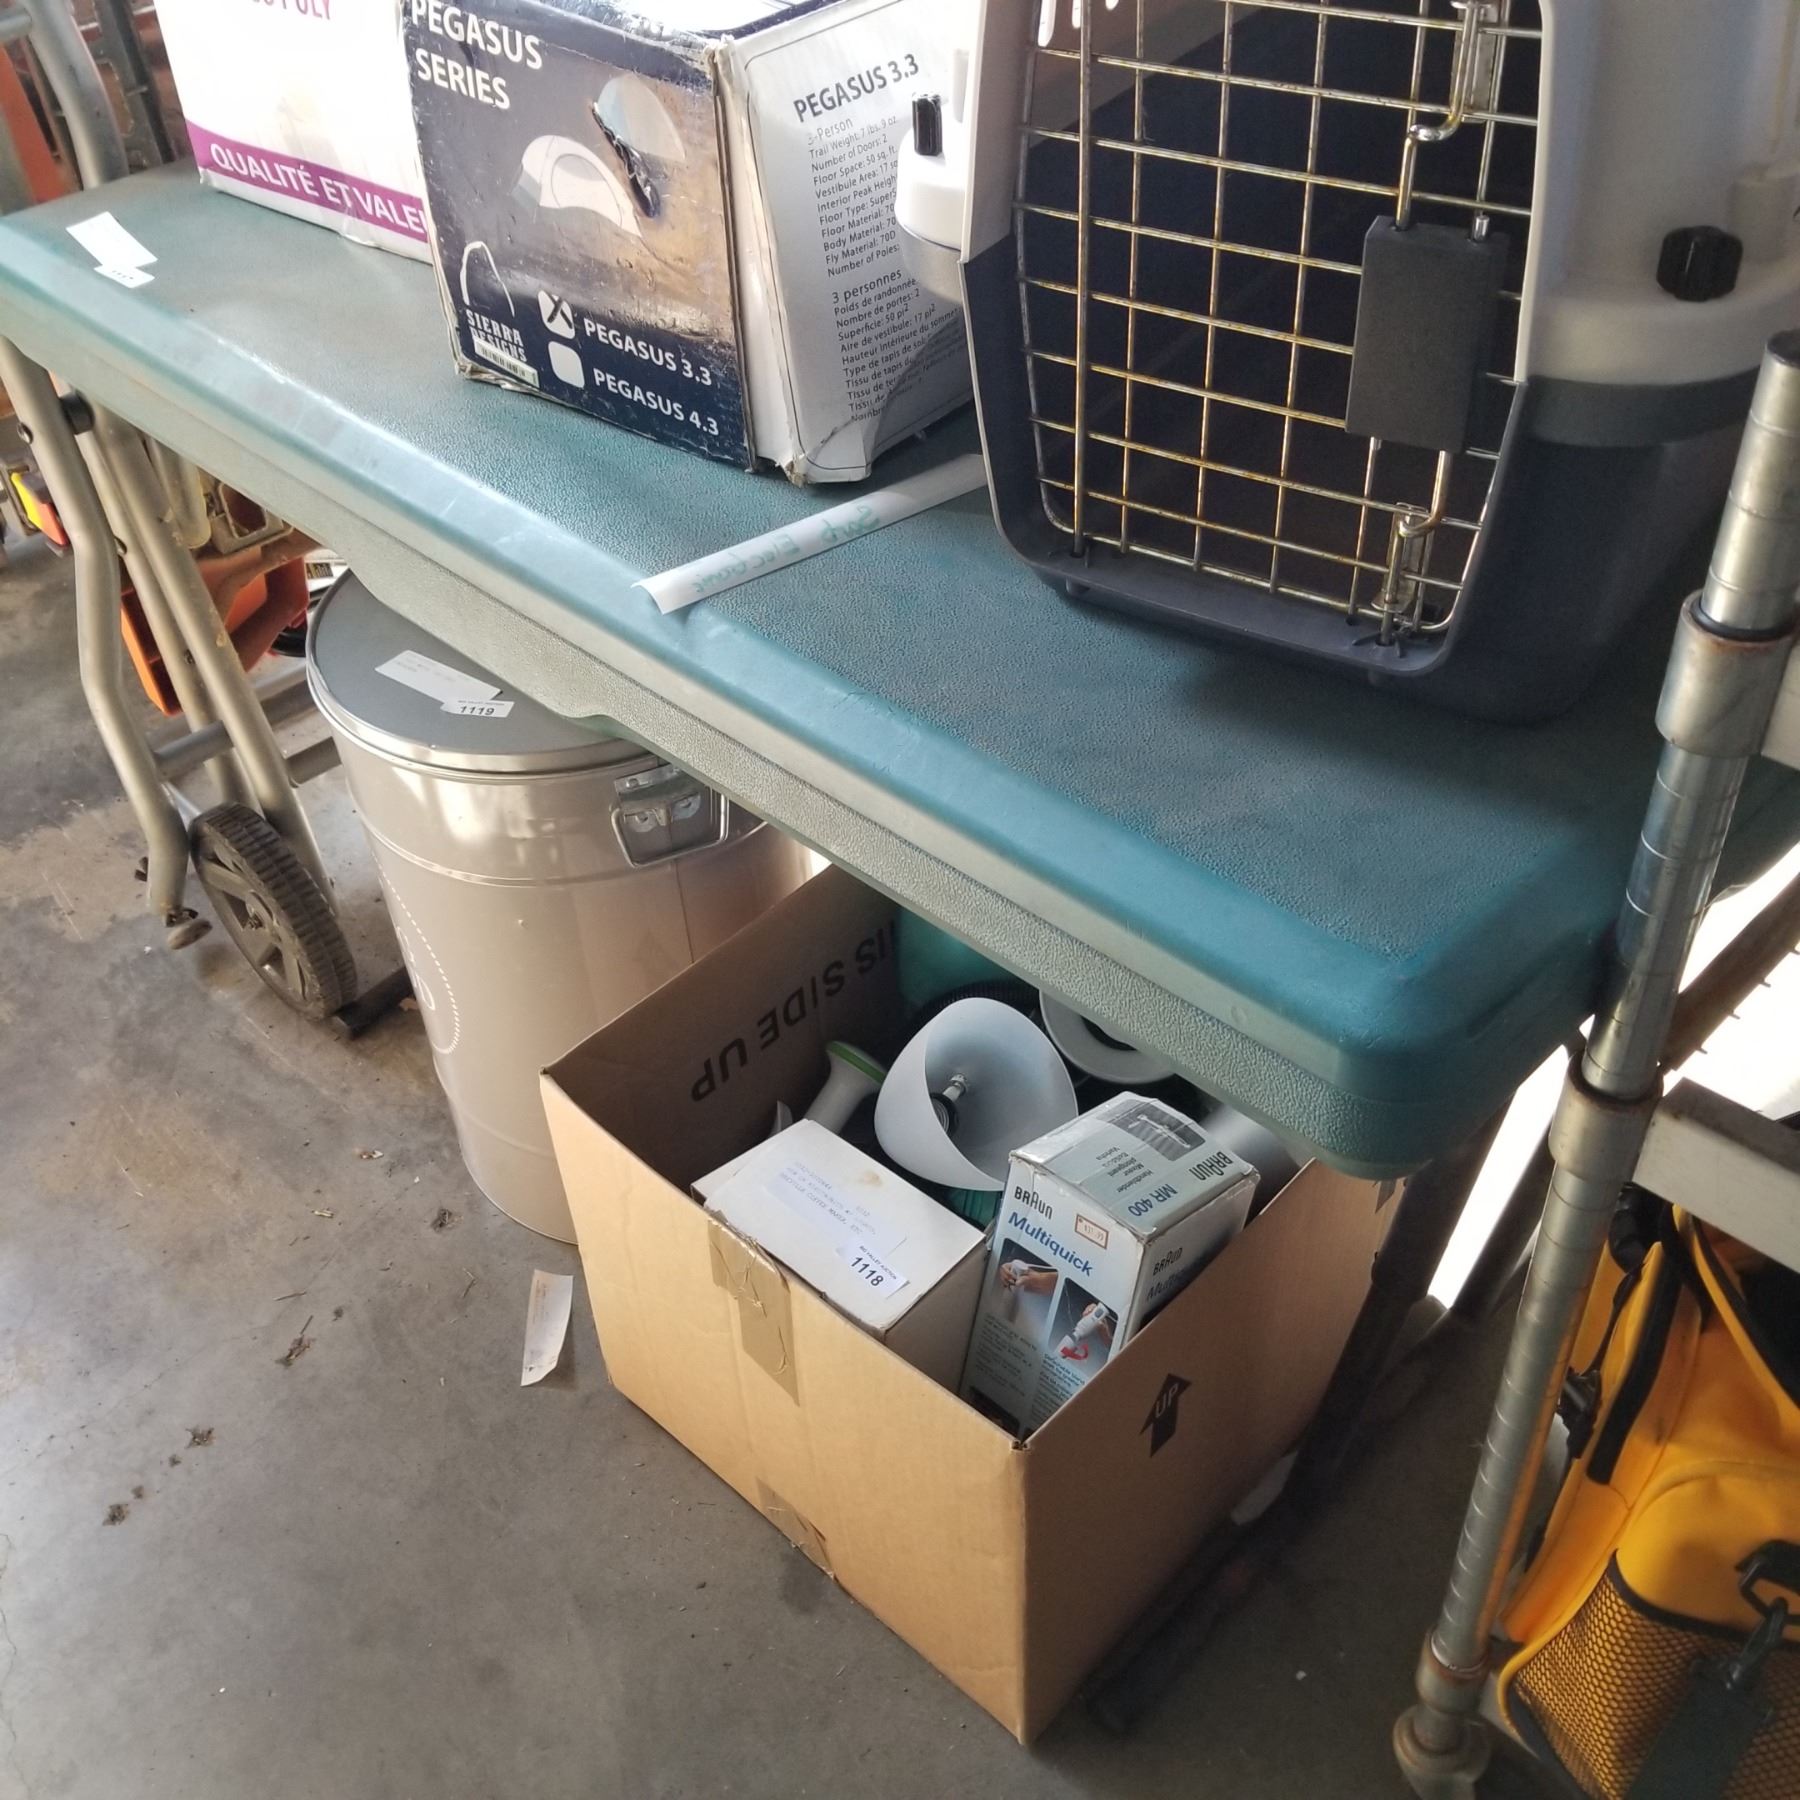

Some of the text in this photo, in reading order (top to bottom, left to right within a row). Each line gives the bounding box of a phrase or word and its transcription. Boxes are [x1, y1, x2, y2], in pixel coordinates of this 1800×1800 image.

[410, 0, 543, 70] PEGASUS
[415, 47, 511, 110] SERIES
[793, 53, 919, 123] PEGASUS 3.3
[811, 133, 888, 173] Number of Doors: 2
[813, 171, 837, 187] Floor
[839, 160, 866, 177] Space:
[866, 153, 876, 166] 50
[210, 143, 319, 197] QUALITÉ
[320, 175, 352, 208] ET
[815, 178, 857, 200] Vestibule
[859, 169, 879, 184] Area:
[879, 162, 888, 174] 17
[817, 174, 897, 212] Interior Peak Heigh
[819, 211, 843, 226] Floor
[845, 202, 869, 218] Type:
[821, 225, 845, 239] Floor
[847, 207, 884, 230] Material:
[823, 238, 847, 252] Body
[849, 221, 884, 244] Material:
[825, 253, 839, 265] Fly
[841, 237, 879, 259] Material:
[827, 243, 900, 278] Number of Poles:
[832, 268, 902, 304] 3 personnes
[834, 301, 859, 316] Poids
[862, 295, 872, 307] de
[836, 287, 921, 329] Nombre de portes: 2
[466, 308, 524, 348] SIERRA
[838, 322, 885, 342] Superficie:
[885, 312, 896, 325] 50
[840, 340, 859, 354] Aire
[861, 335, 873, 347] de
[874, 319, 913, 342] vestibule:
[914, 311, 923, 323] 17
[841, 349, 878, 365] Hauteur
[919, 324, 930, 334] du
[583, 317, 713, 387] PEGASUS 3.3
[843, 365, 866, 378] Type
[868, 359, 880, 370] de
[881, 350, 901, 364] tapis
[901, 344, 912, 355] de
[846, 375, 869, 390] Tissu
[871, 370, 882, 381] de
[883, 361, 903, 376] tapis
[848, 387, 871, 401] Tissu
[873, 381, 884, 393] de
[593, 368, 720, 437] PEGASUS 4.3
[460, 705, 495, 716] 1119
[757, 959, 846, 1051] SIDE
[691, 1037, 748, 1101] UP
[1188, 1151, 1234, 1182] BRAUN
[1013, 1185, 1053, 1220] BRAUN
[1127, 1183, 1178, 1218] MR 400
[1008, 1211, 1094, 1277] Multiquick
[1153, 1247, 1183, 1276] BRAUN
[851, 1257, 884, 1287] 1118
[1154, 1382, 1180, 1419] UP
